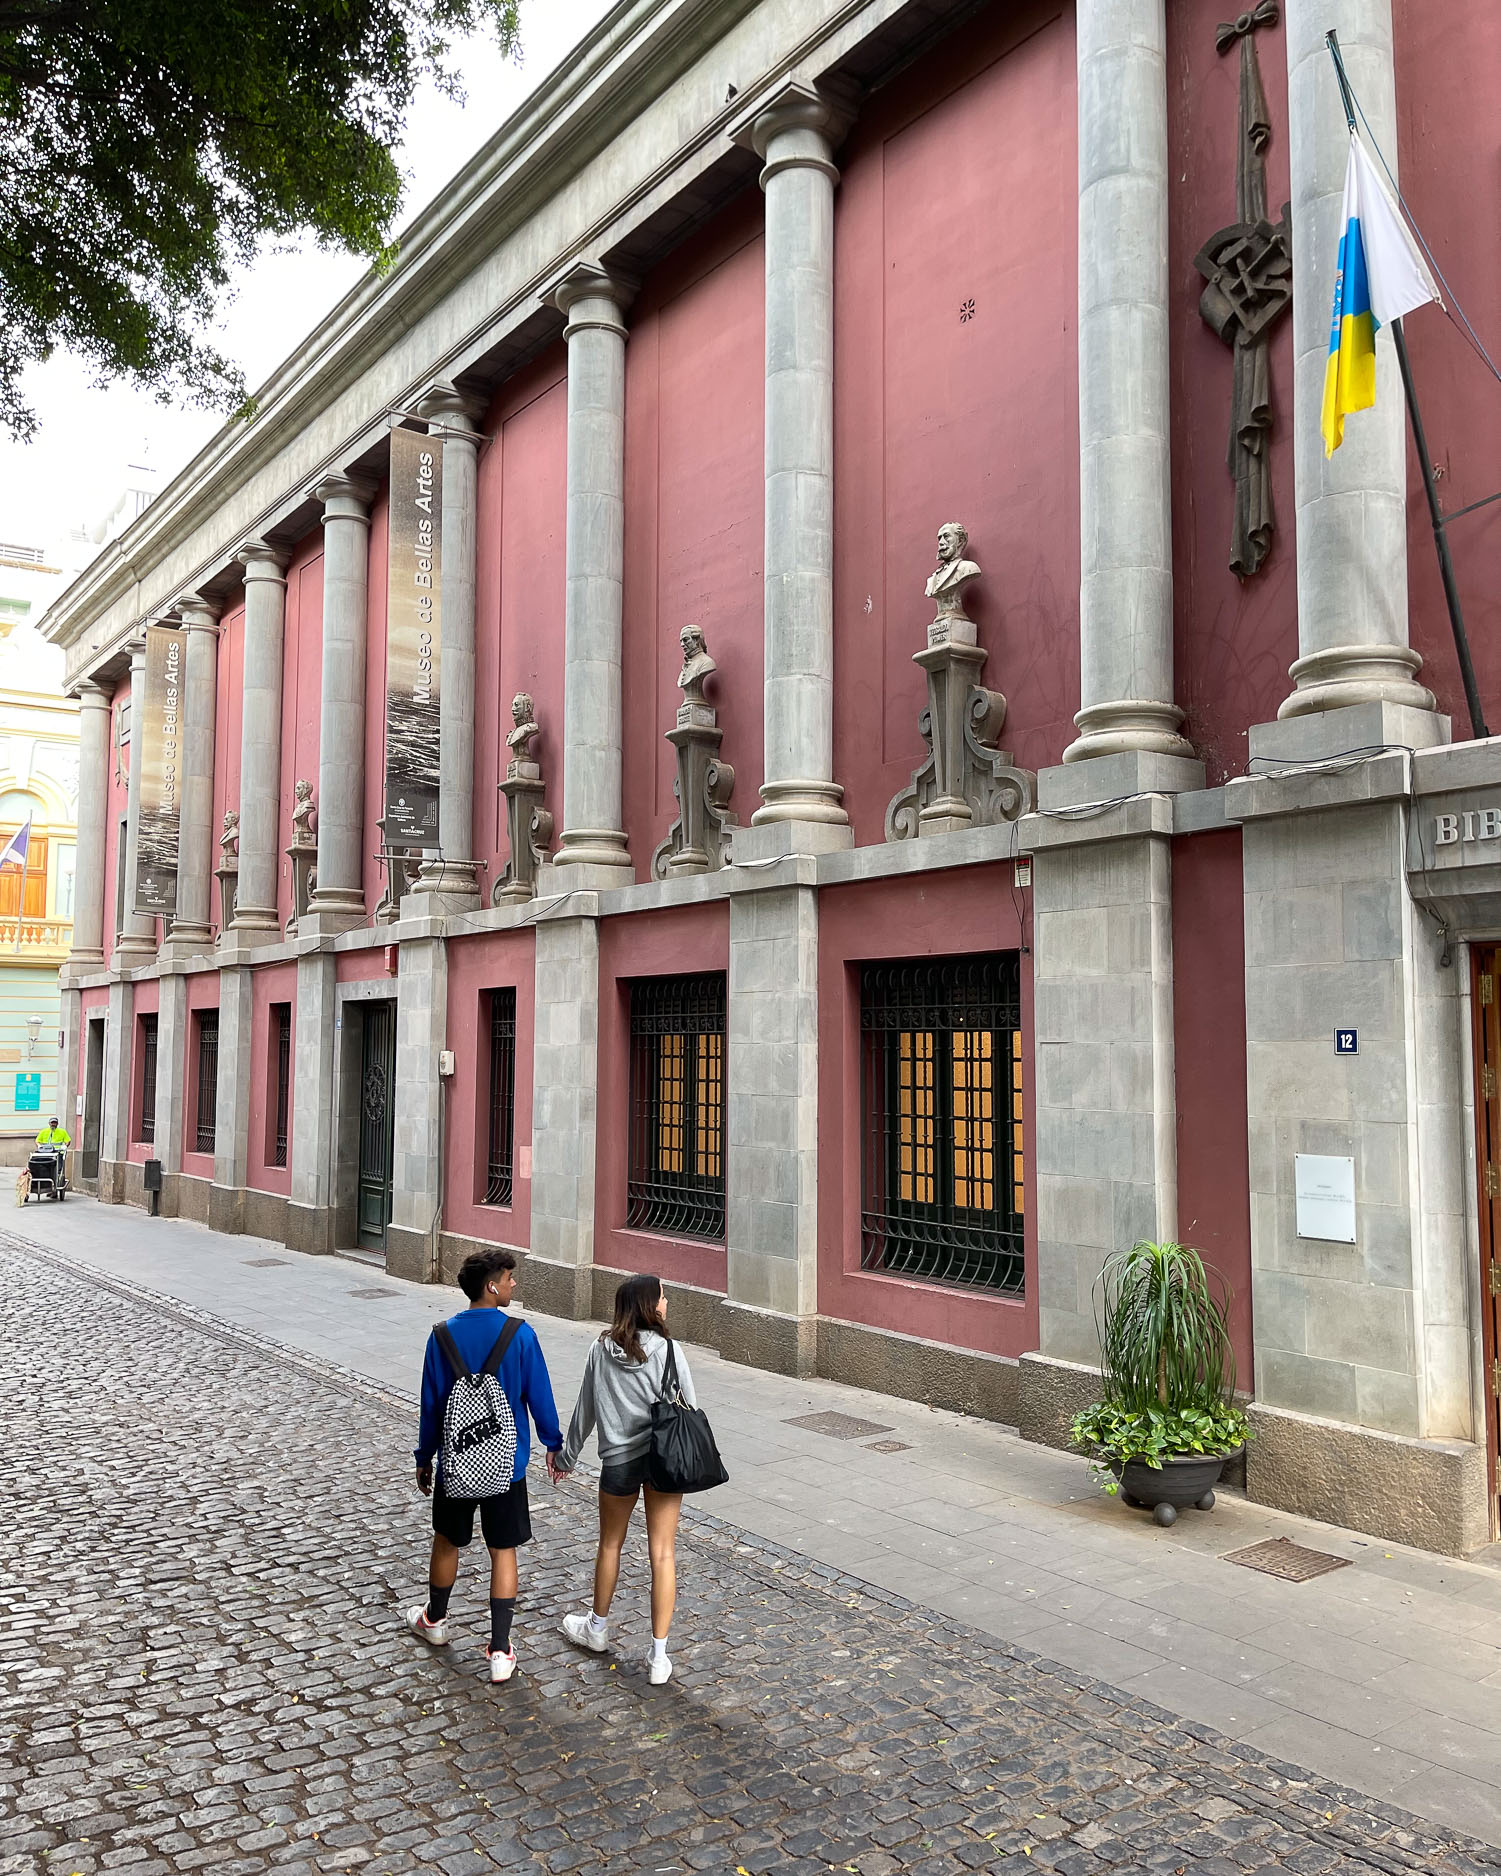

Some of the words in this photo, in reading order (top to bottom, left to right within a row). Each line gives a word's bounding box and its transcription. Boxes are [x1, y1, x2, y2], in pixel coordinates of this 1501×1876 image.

[415, 452, 434, 514] Artes
[414, 519, 433, 589] Bellas
[414, 596, 433, 624] de
[164, 642, 180, 684] Artes
[412, 631, 432, 705] Museo
[162, 687, 179, 736] Bellas
[163, 740, 177, 759] de
[160, 763, 176, 815] Museo
[1340, 1034, 1353, 1048] 12
